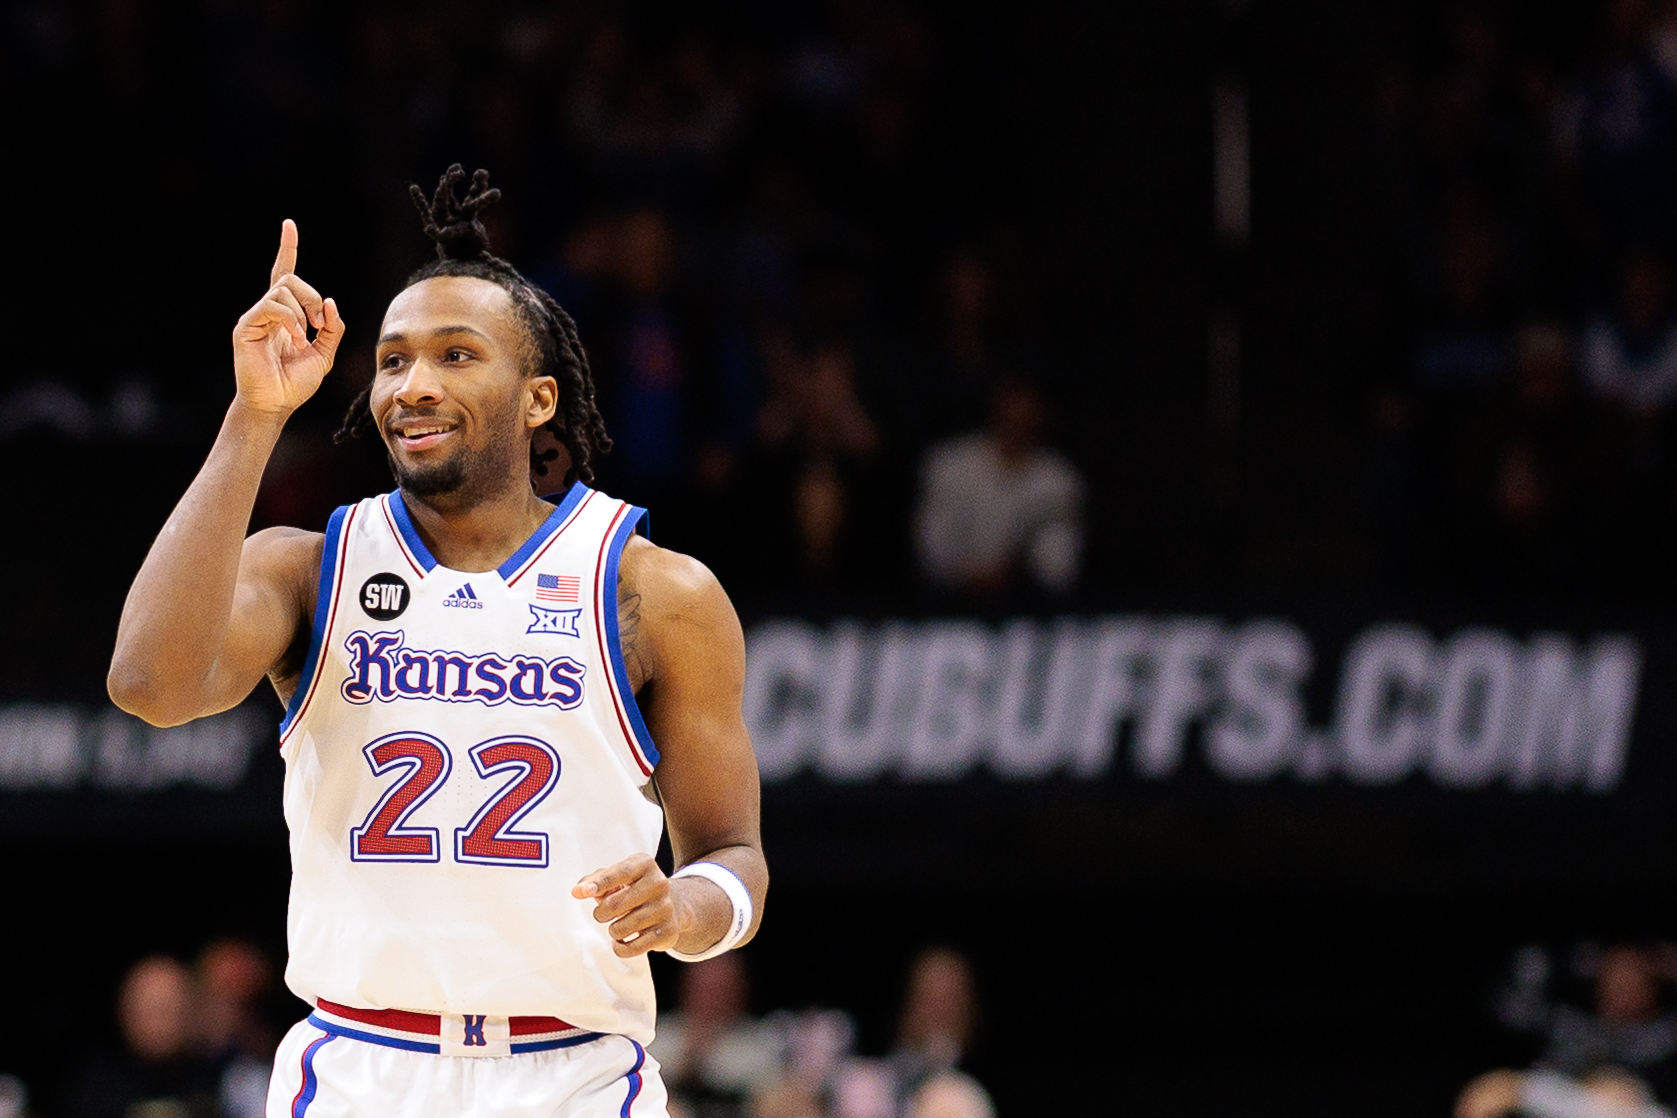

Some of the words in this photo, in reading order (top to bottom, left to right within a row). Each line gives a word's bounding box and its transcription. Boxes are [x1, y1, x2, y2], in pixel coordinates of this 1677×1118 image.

[364, 583, 404, 610] SW
[443, 598, 483, 609] adidas
[342, 630, 586, 711] Kansas
[743, 614, 1646, 792] CUBUFFS.COM
[350, 731, 561, 868] 22
[462, 1015, 487, 1047] K
